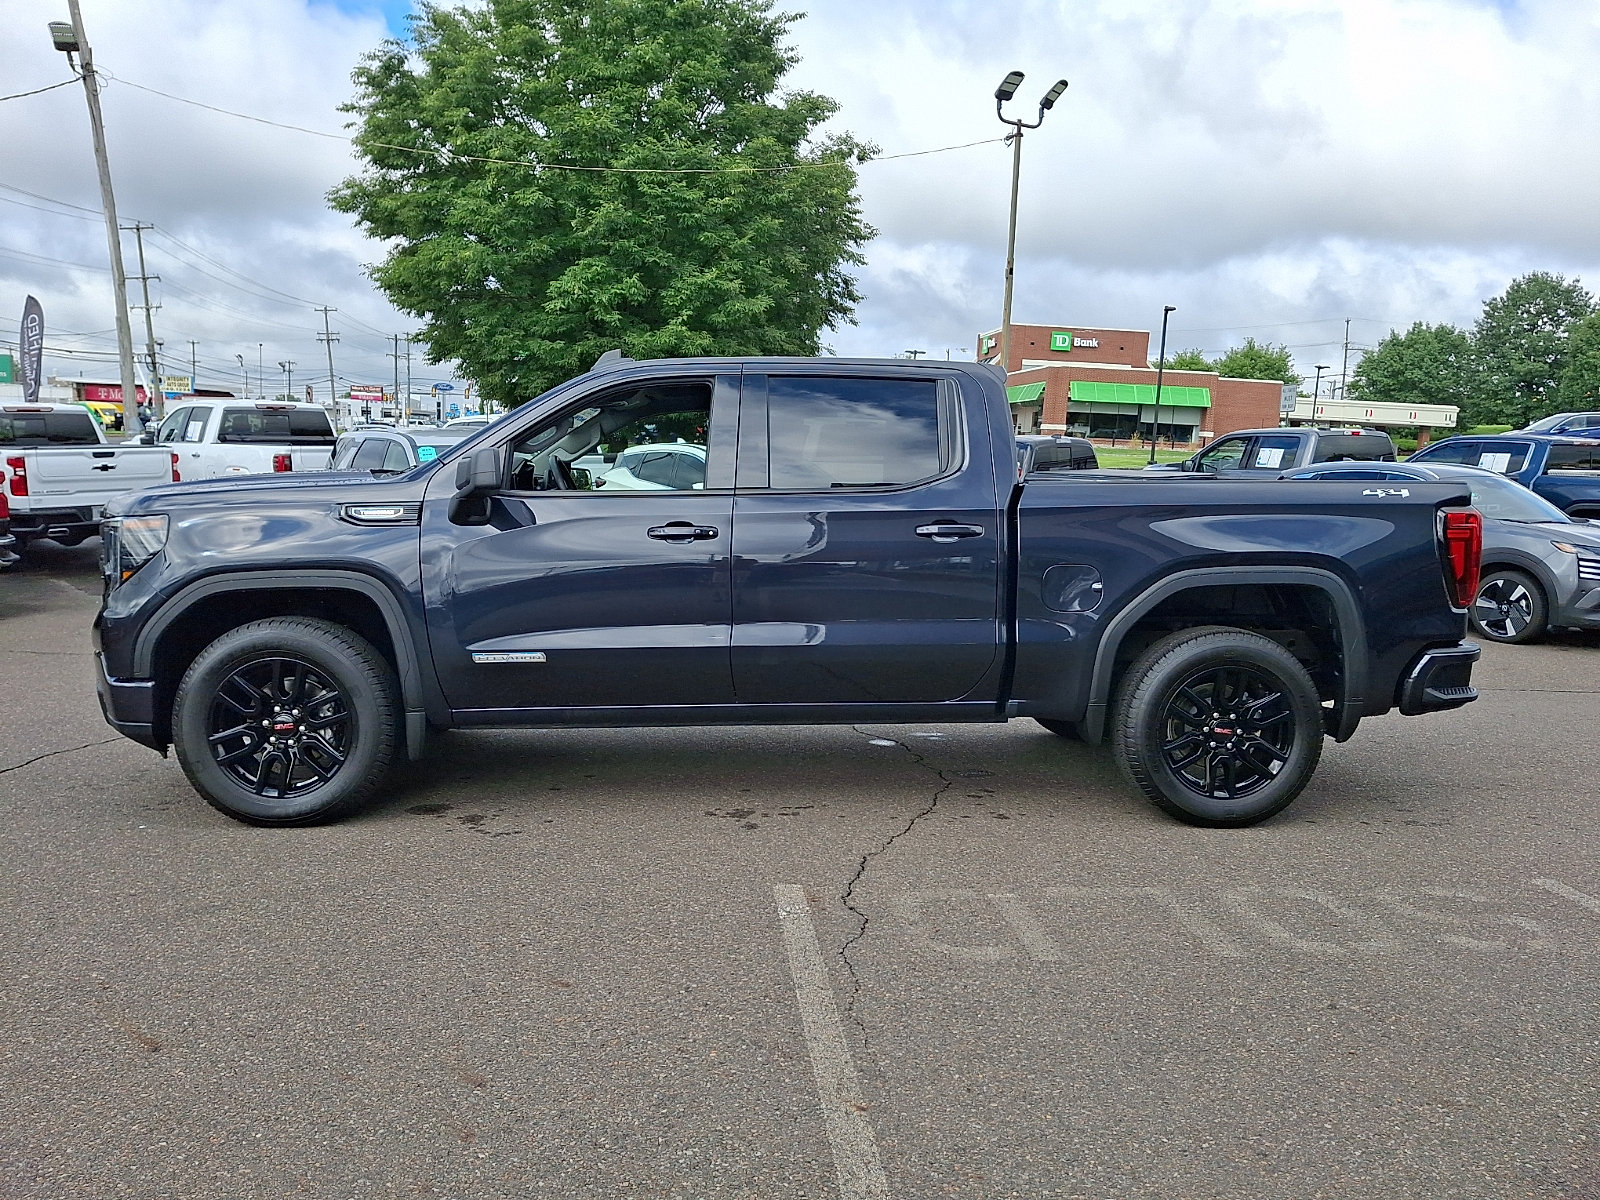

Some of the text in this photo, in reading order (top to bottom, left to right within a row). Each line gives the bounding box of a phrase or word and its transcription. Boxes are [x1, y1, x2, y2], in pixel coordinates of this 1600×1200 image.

[1053, 334, 1099, 348] TD Bank
[473, 654, 545, 662] ELEVATION
